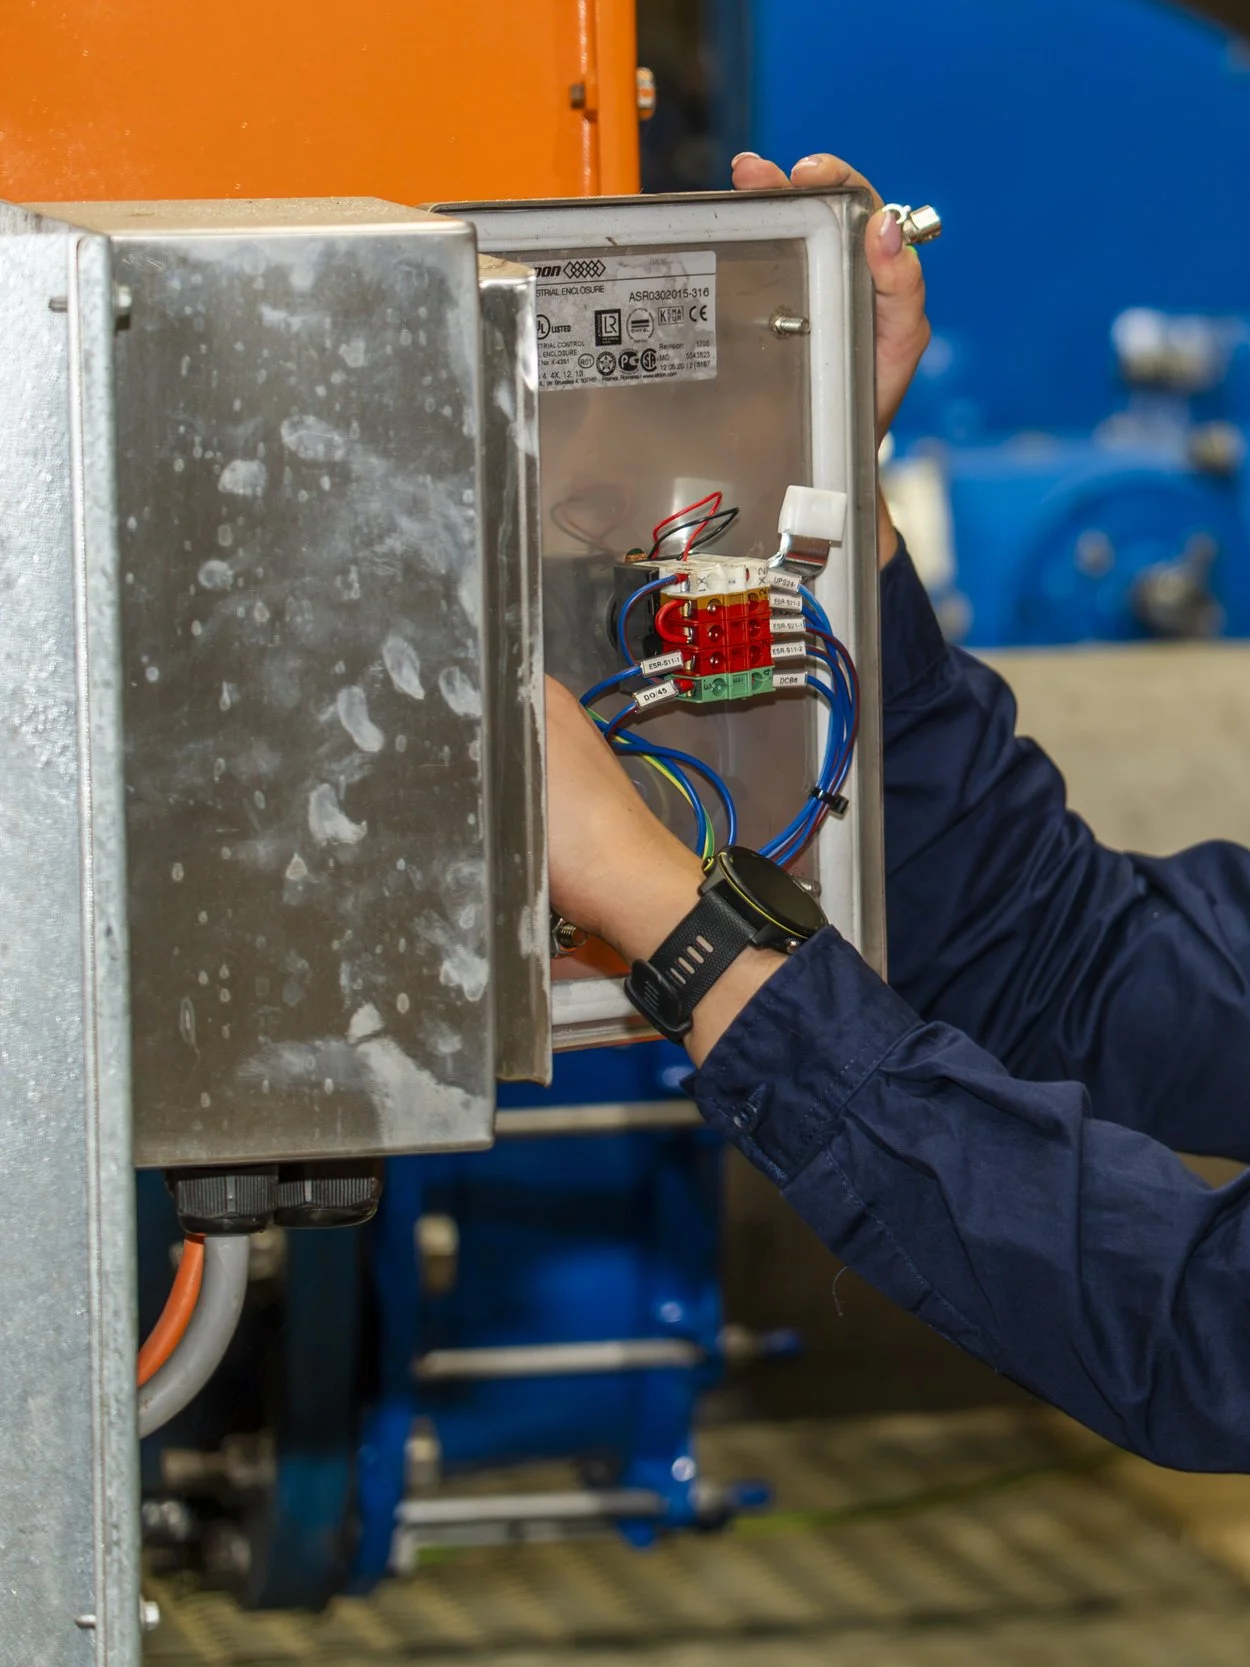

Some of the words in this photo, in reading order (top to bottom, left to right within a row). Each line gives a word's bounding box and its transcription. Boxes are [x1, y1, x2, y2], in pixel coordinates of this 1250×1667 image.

[562, 285, 604, 295] ENCLOSURE
[629, 288, 709, 302] ASR0302015-316
[551, 325, 571, 333] LISTED
[557, 340, 584, 348] CONTROL
[543, 349, 577, 358] ENCLOSURE
[648, 657, 680, 670] ESR-S11-1
